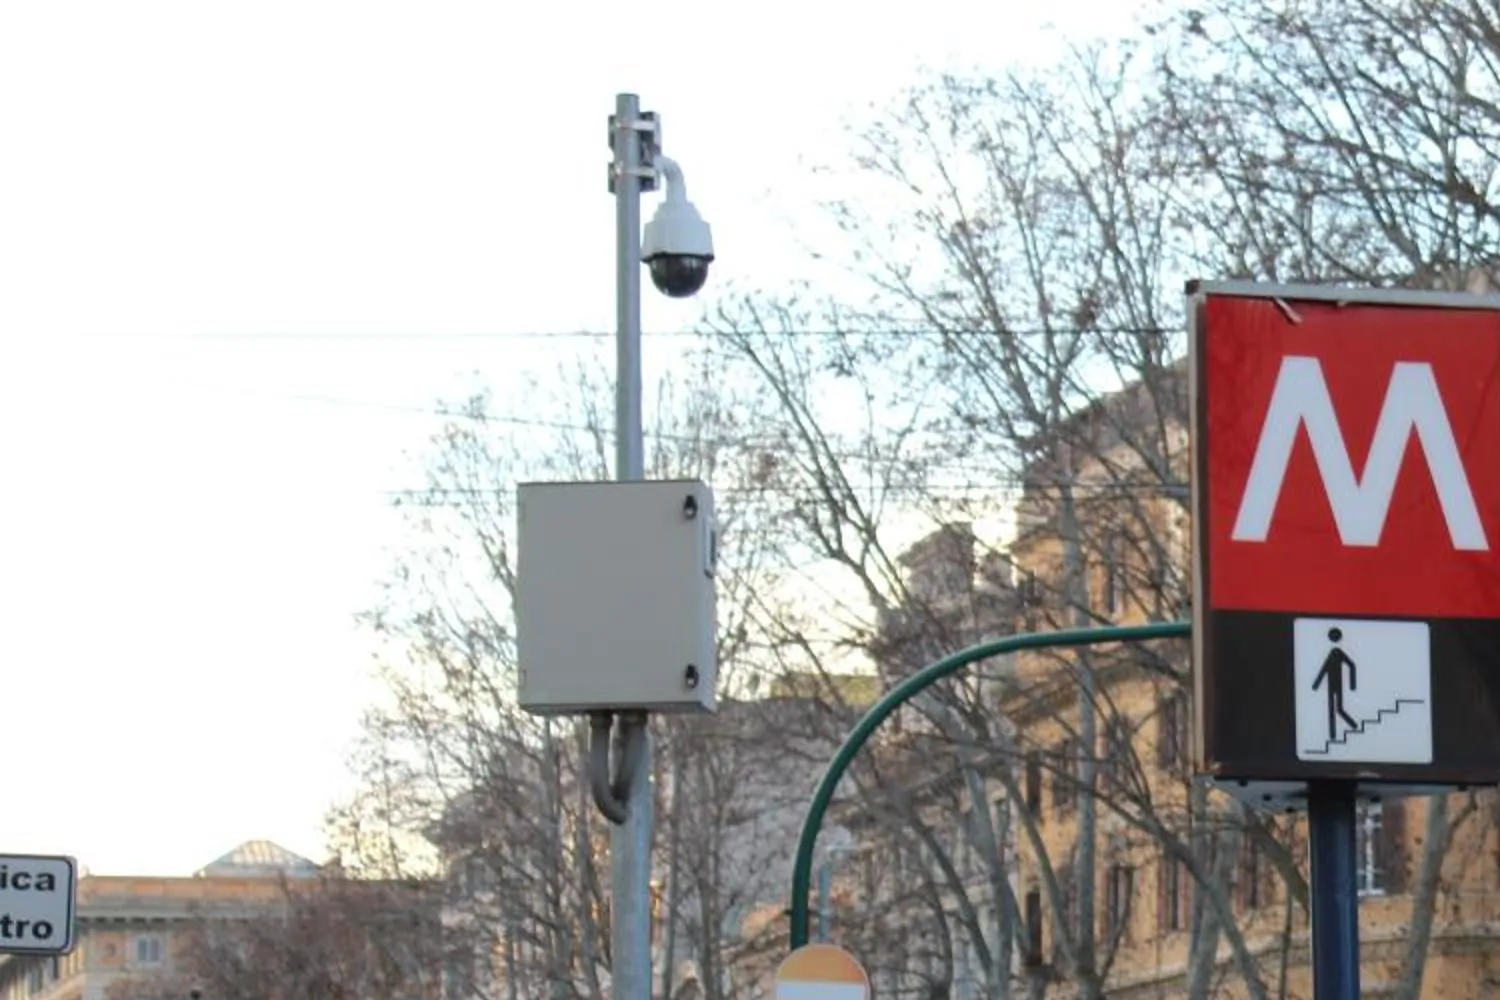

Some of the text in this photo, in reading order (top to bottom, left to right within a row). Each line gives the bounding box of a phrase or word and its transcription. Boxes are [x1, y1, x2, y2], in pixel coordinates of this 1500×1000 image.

[1231, 355, 1490, 551] M
[0, 864, 55, 891] ica
[0, 913, 53, 939] tro
